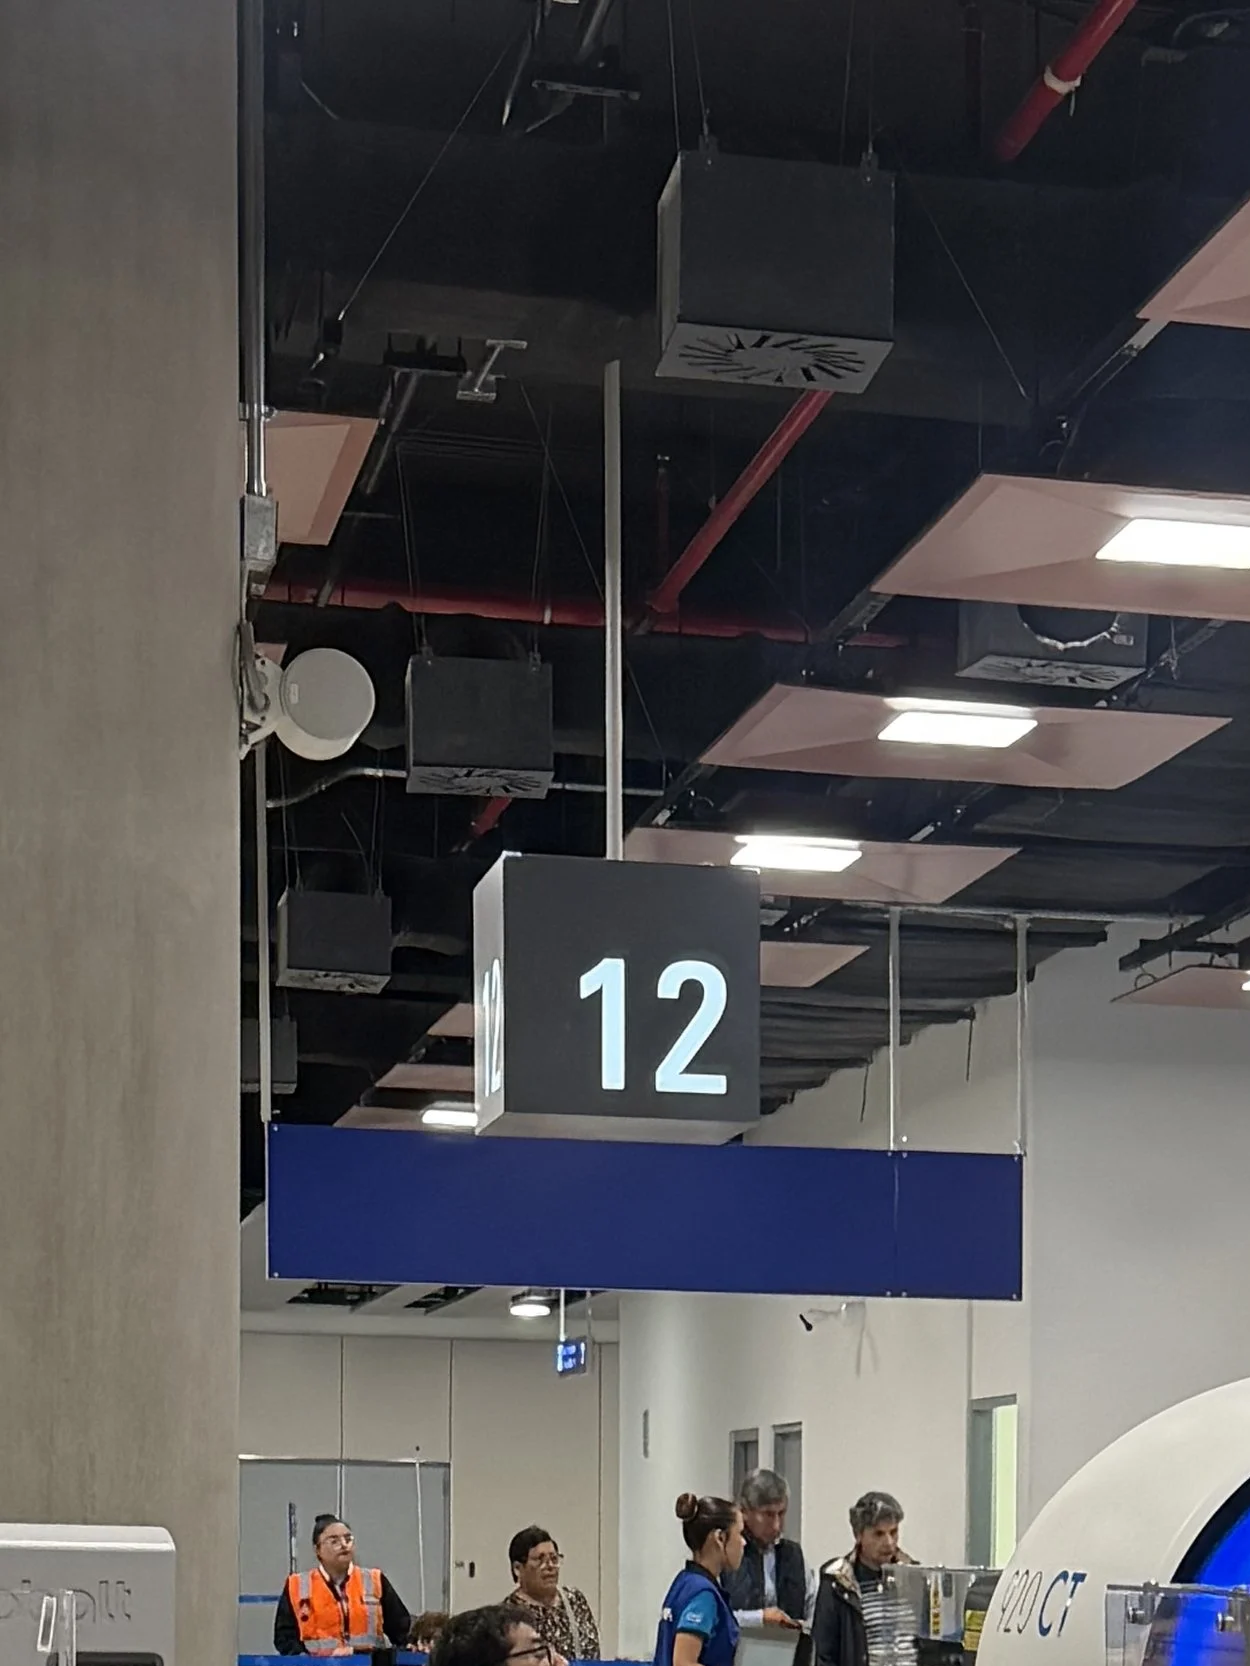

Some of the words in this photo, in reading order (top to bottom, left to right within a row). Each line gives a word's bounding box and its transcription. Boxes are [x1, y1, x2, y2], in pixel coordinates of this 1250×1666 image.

[482, 957, 501, 1098] 12
[579, 957, 728, 1095] 12
[1038, 1569, 1088, 1638] CT
